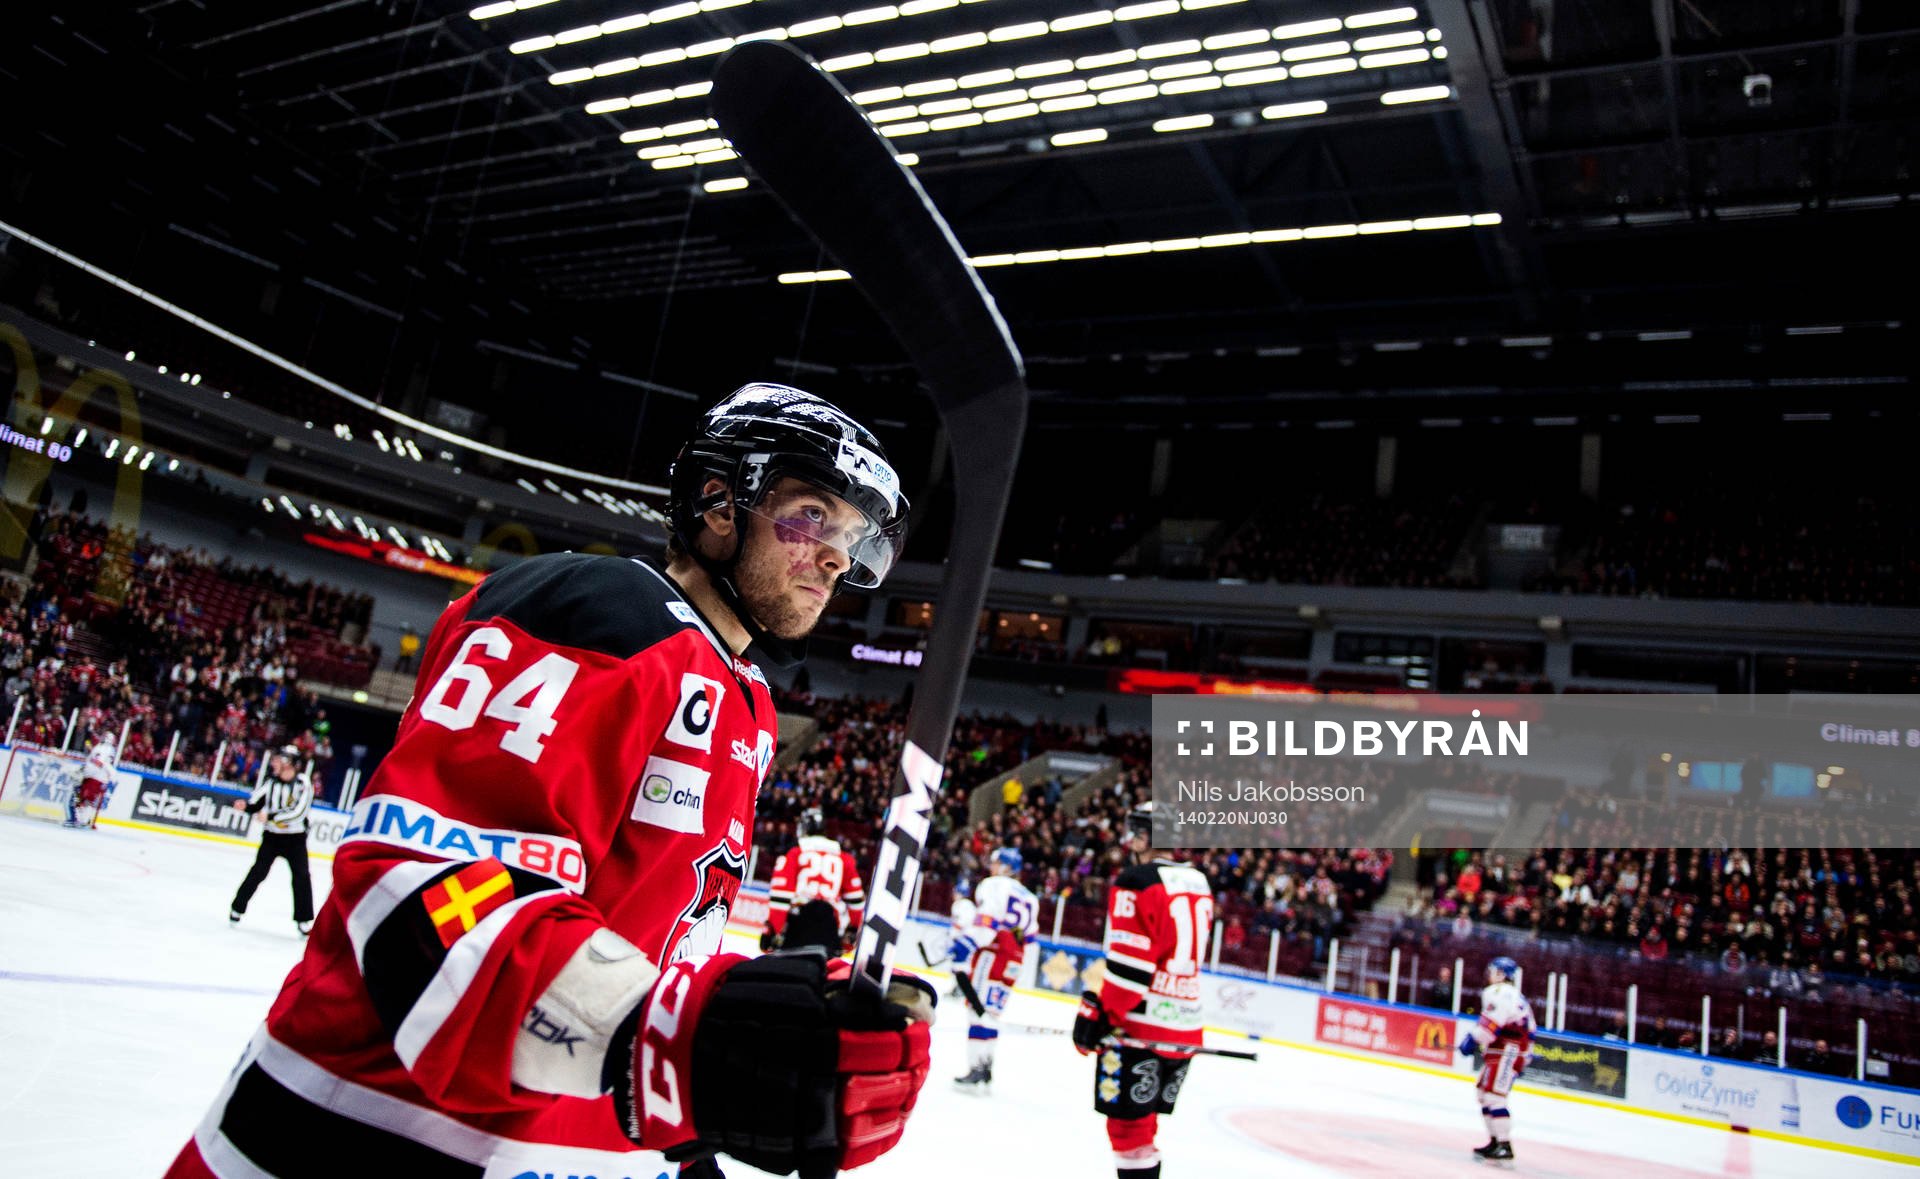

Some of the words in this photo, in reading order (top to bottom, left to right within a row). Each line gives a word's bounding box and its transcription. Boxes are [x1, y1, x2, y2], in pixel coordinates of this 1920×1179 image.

[47, 442, 72, 462] 80
[851, 644, 902, 665] Climat
[419, 627, 580, 764] 64
[1821, 723, 1899, 746] Climat
[137, 789, 250, 832] stadium
[797, 852, 844, 901] 29
[1113, 890, 1137, 918] 16
[1654, 1071, 1756, 1109] ColdZyme
